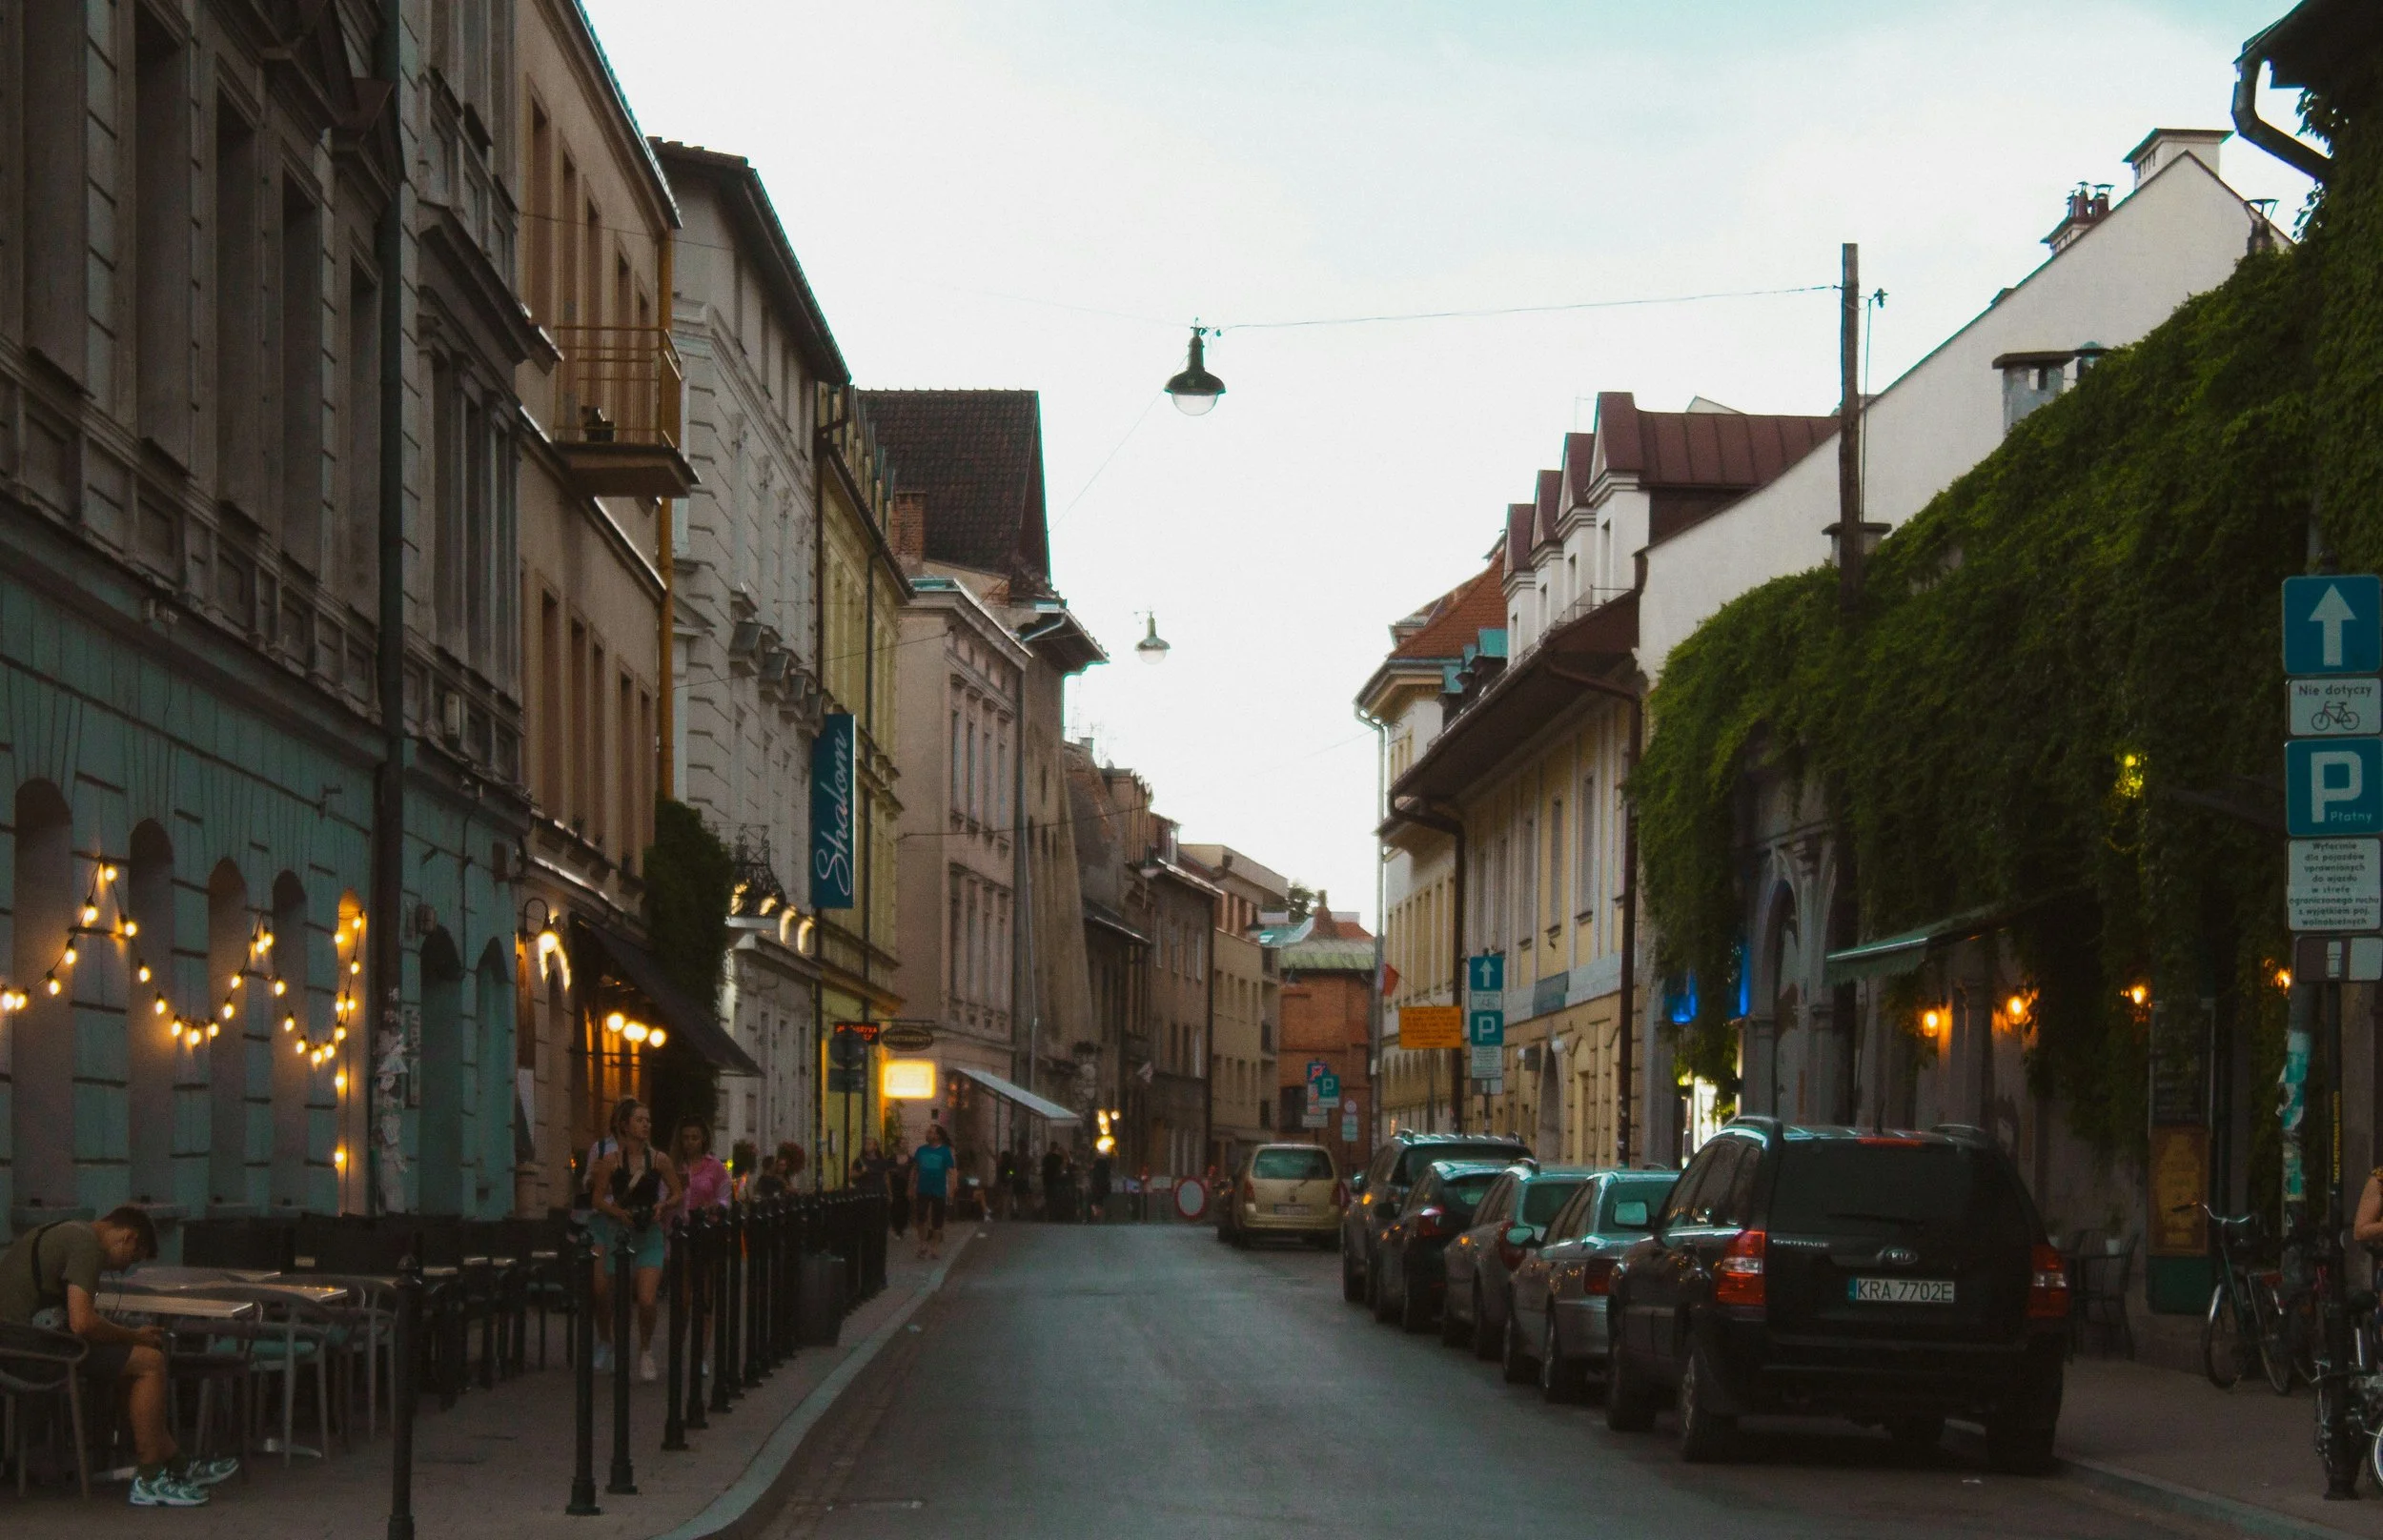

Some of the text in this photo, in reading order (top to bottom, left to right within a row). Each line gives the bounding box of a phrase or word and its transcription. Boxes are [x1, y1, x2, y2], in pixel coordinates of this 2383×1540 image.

[2298, 683, 2373, 699] Nie dotyczy
[2312, 750, 2362, 823] P
[815, 728, 851, 897] Shalom
[2330, 810, 2373, 824] Płatny
[2305, 853, 2319, 861] dla
[2304, 863, 2366, 873] uprawnionych
[2289, 894, 2380, 906] ograniczonego ruchu
[2352, 906, 2371, 917] poj.
[1477, 1016, 1496, 1042] P
[1322, 1078, 1334, 1094] P
[1891, 1250, 1912, 1261] KIA
[1858, 1280, 1953, 1303] KRA 7702E
